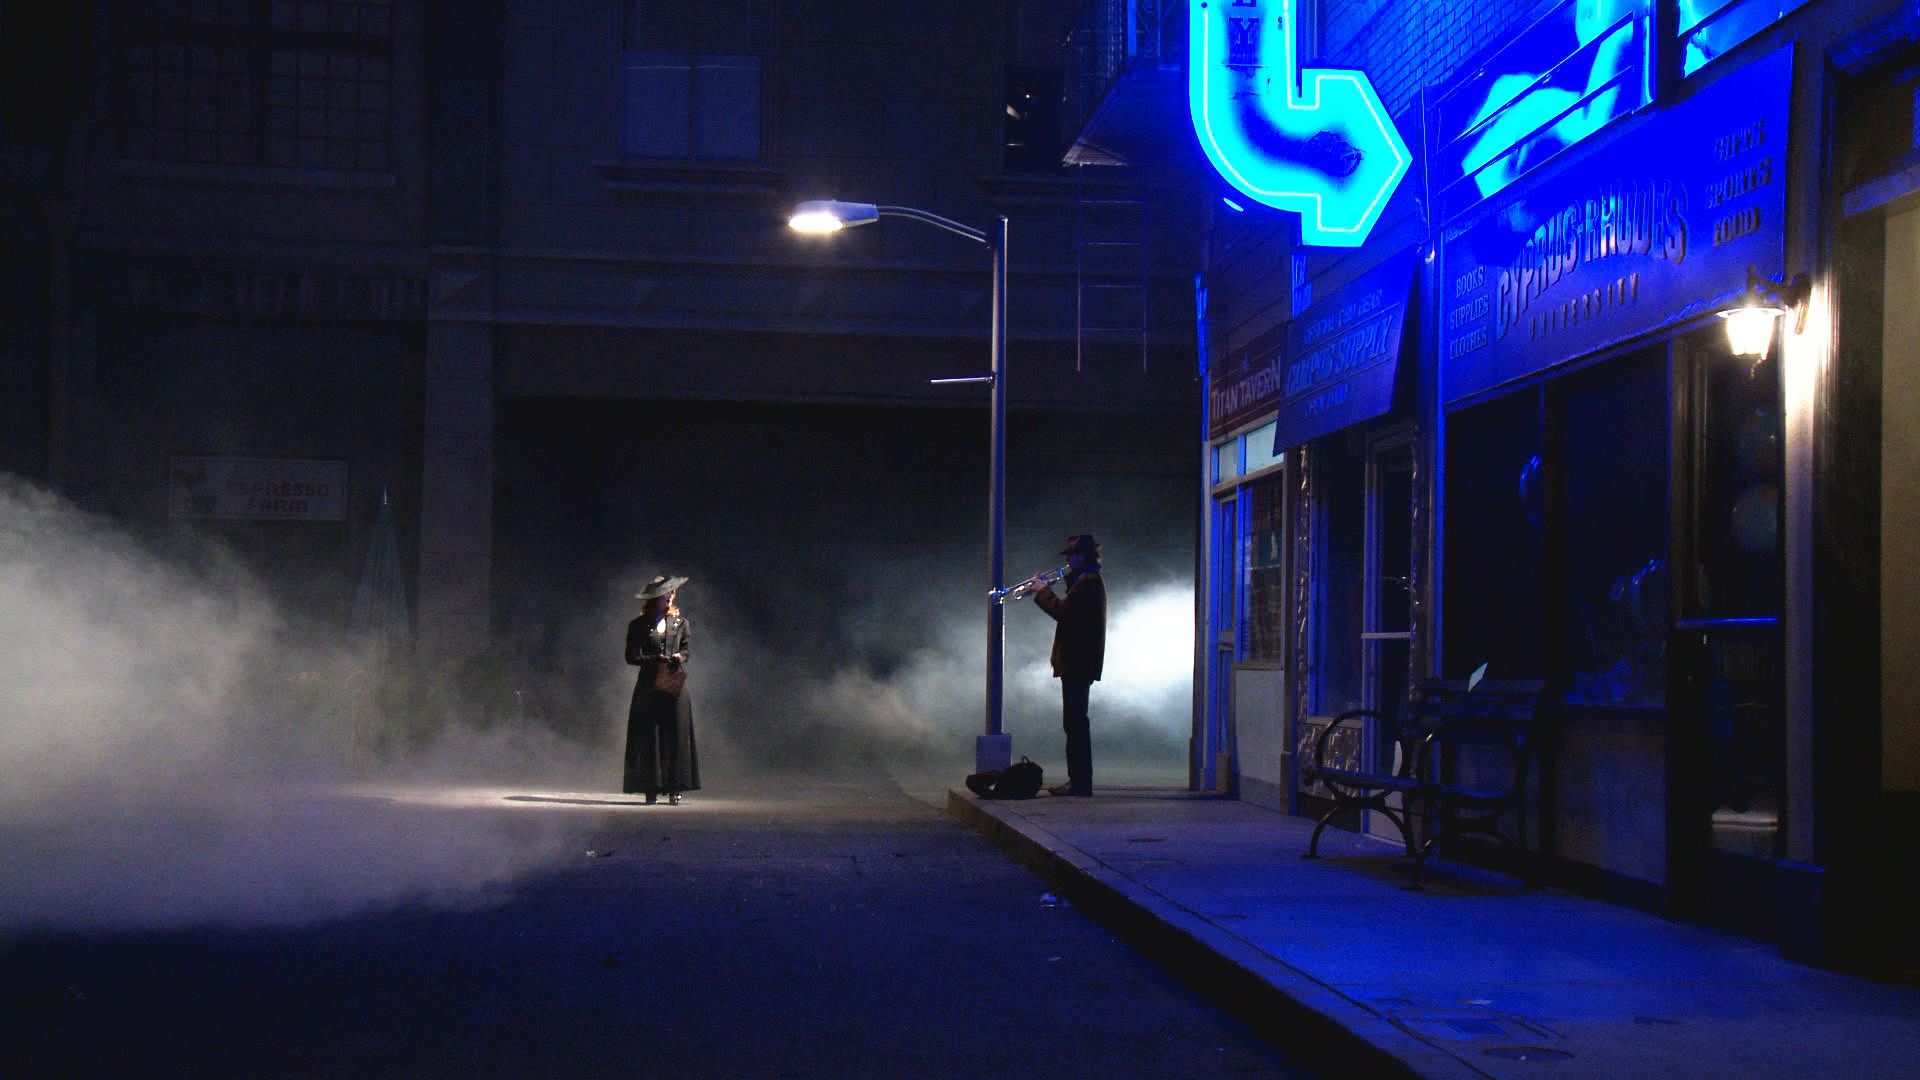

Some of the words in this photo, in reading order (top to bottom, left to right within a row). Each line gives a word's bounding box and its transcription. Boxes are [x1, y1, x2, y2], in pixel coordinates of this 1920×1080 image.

[1706, 156, 1773, 209] SPORTS
[1714, 205, 1762, 248] FOOD
[1456, 265, 1485, 299] BOOKS
[1449, 294, 1489, 331] SUPPLIES
[1527, 272, 1642, 343] UNIVERSITY
[1334, 313, 1395, 377] SUPPLY
[1449, 325, 1488, 361] CLOTHES
[1210, 382, 1239, 421] TITAN
[1238, 354, 1281, 407] TAVERN
